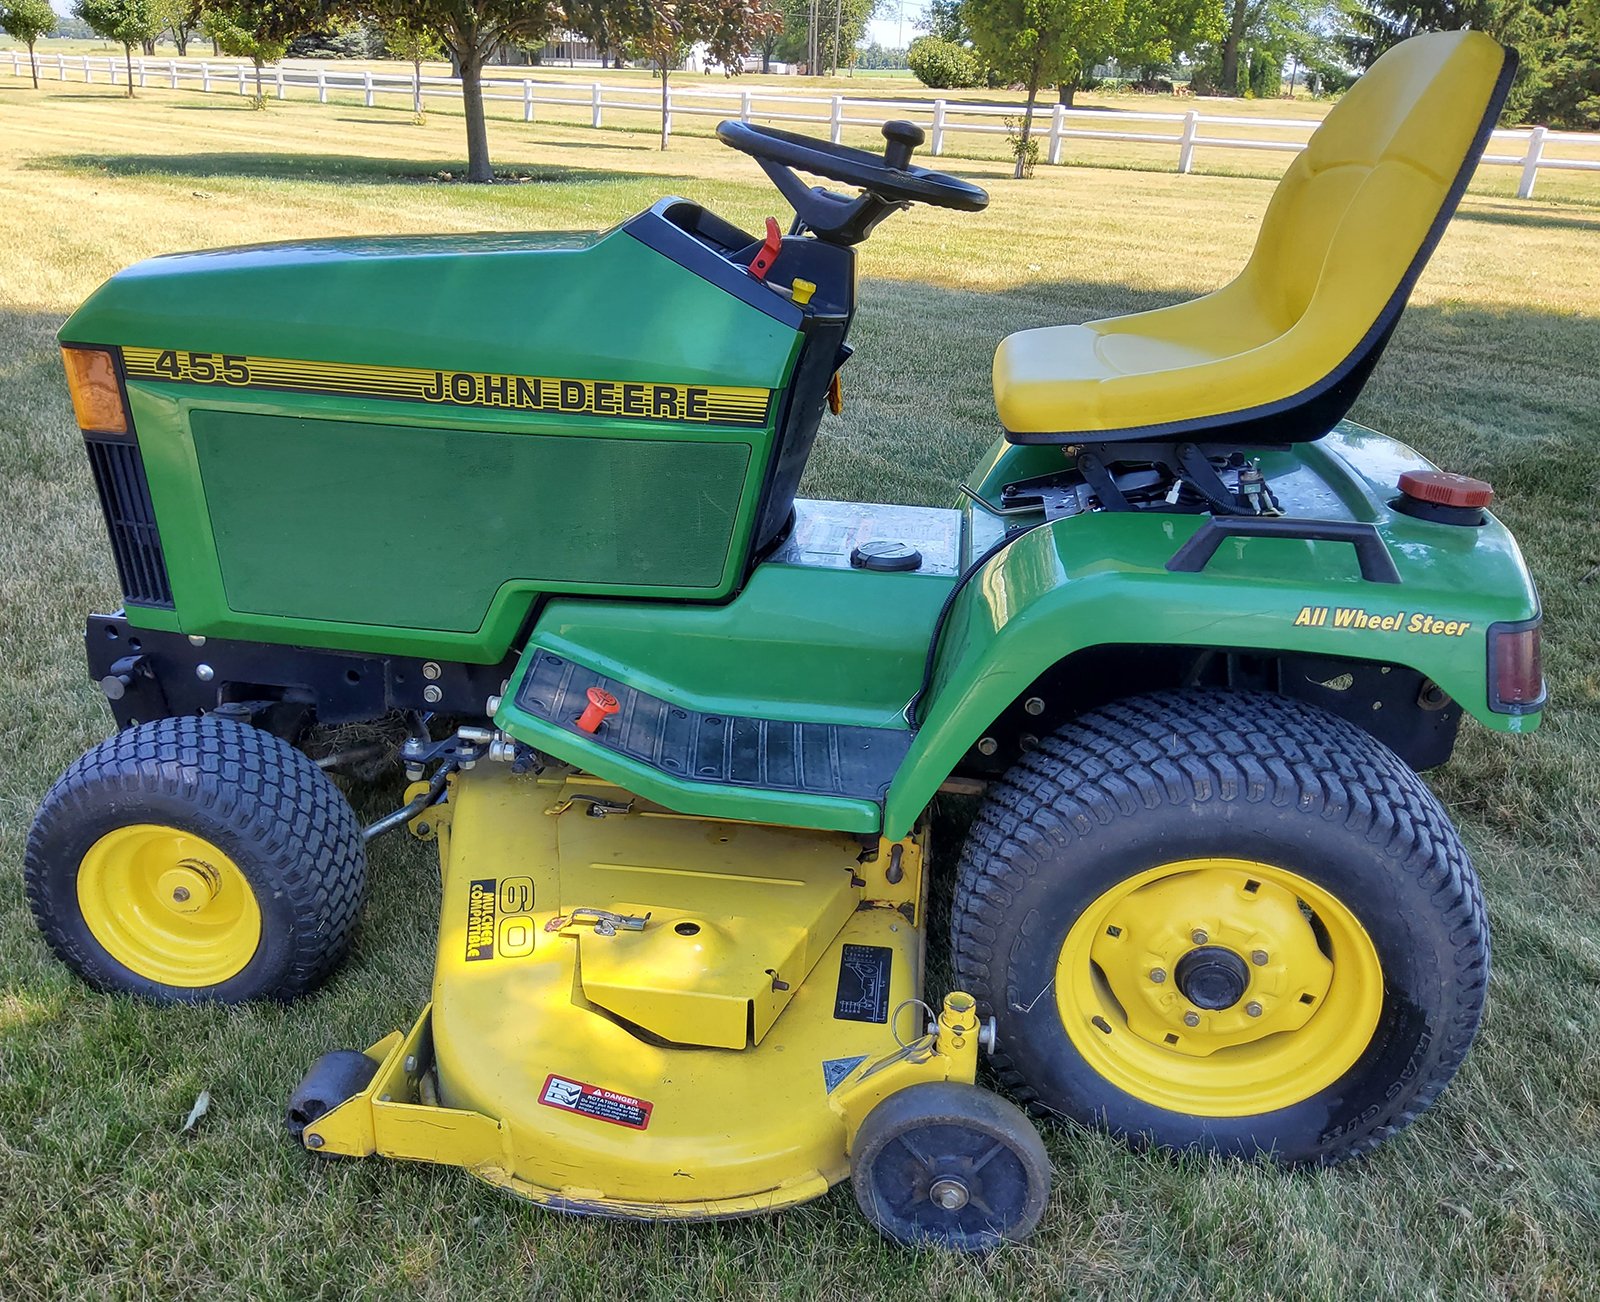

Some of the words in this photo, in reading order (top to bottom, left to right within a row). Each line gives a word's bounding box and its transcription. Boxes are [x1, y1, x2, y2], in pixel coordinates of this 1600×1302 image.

[154, 350, 251, 386] 455
[423, 371, 543, 409] JOHN
[558, 379, 709, 421] DEERE
[1293, 606, 1328, 627] All
[1332, 607, 1406, 632] Wheel
[1406, 613, 1470, 637] Steer
[467, 884, 483, 957] COMPATIBLE
[480, 892, 495, 946] MULCHER
[498, 876, 535, 958] 60
[587, 1095, 618, 1107] ROTATING
[604, 1091, 638, 1105] DANGER
